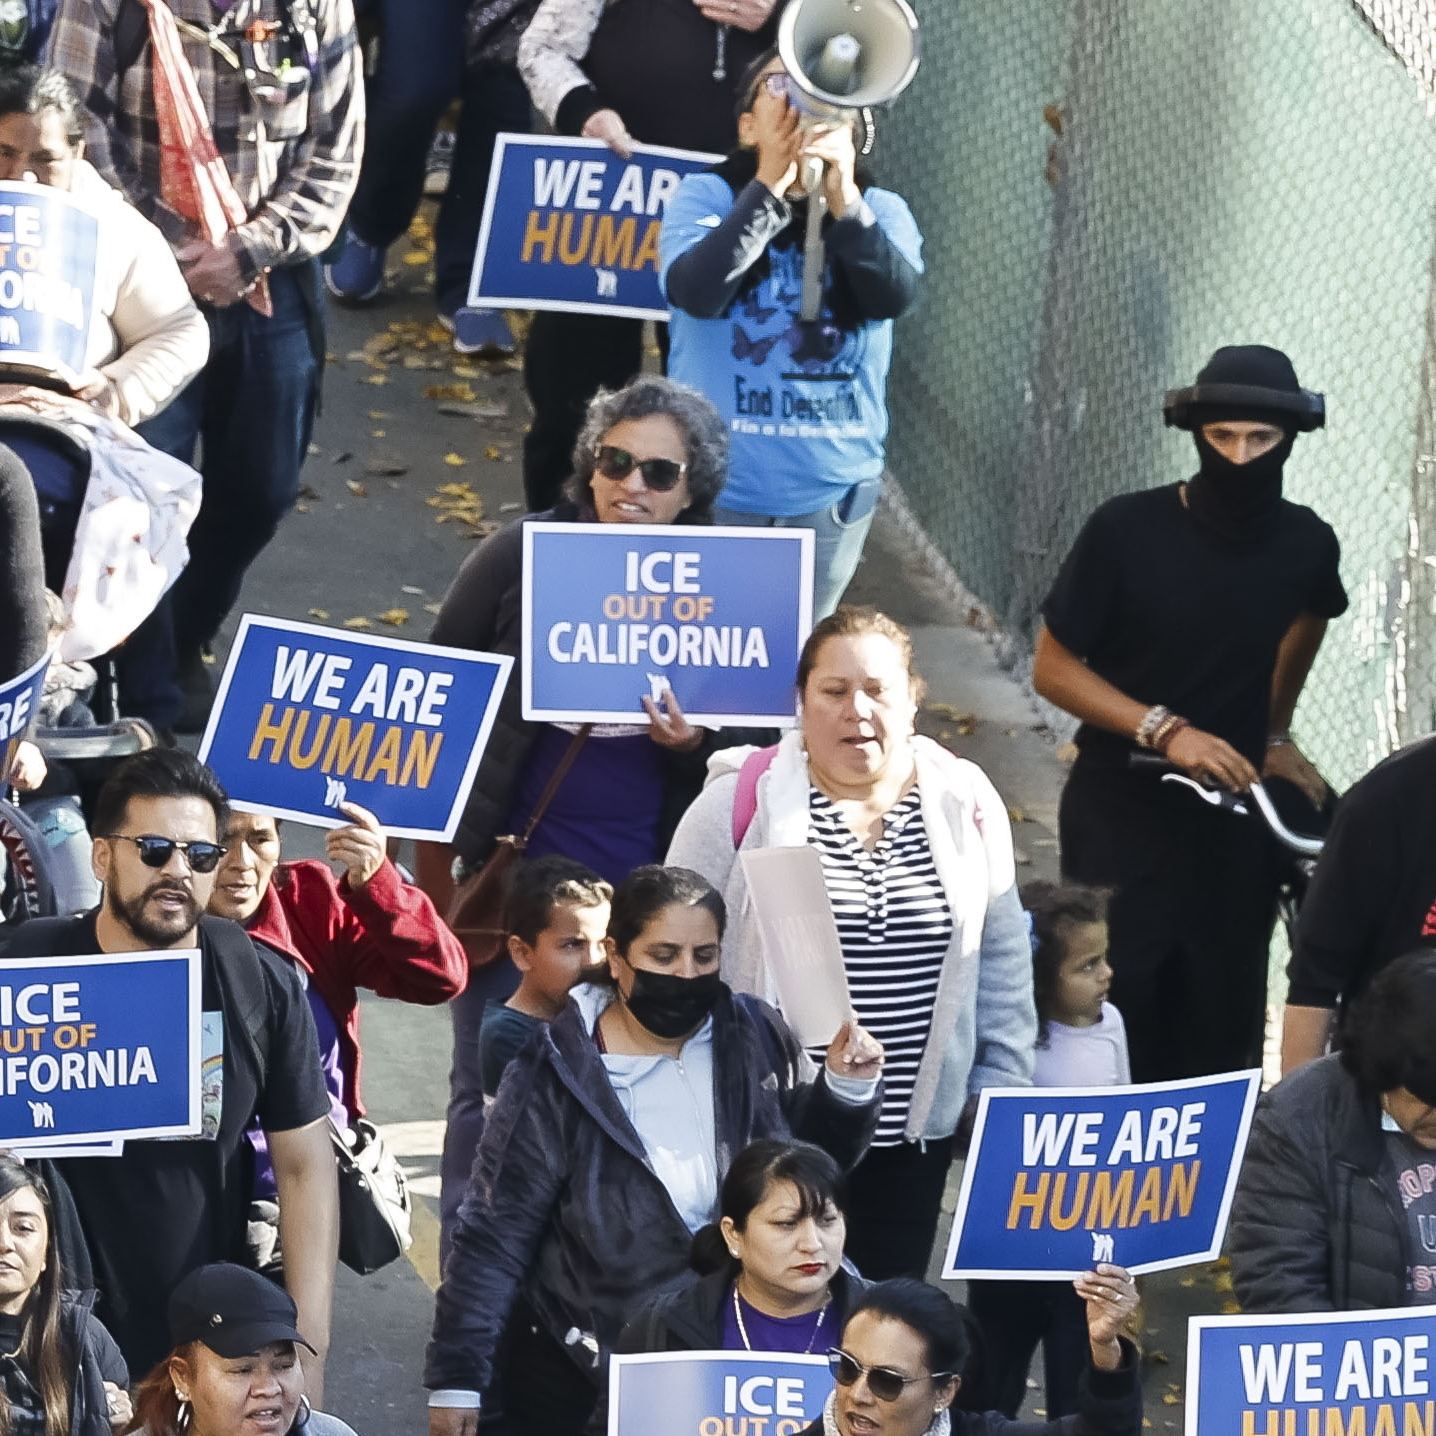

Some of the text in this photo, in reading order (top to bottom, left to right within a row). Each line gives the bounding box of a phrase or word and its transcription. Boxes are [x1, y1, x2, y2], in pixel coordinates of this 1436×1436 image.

[534, 158, 681, 216] WE AR
[16, 247, 39, 269] O
[521, 211, 662, 272] HUMA
[626, 552, 701, 594] ICE
[604, 596, 714, 621] OUT OF
[548, 623, 770, 668] CALIFORNIA
[272, 646, 454, 727] WE ARE
[248, 705, 443, 790] HUMAN
[0, 982, 81, 1026] ICE
[52, 1022, 97, 1050] OF
[1022, 1103, 1207, 1166] WE ARE
[1006, 1160, 1202, 1231] HUMAN
[1239, 1334, 1430, 1403] WE ARE
[724, 1376, 805, 1417] ICE
